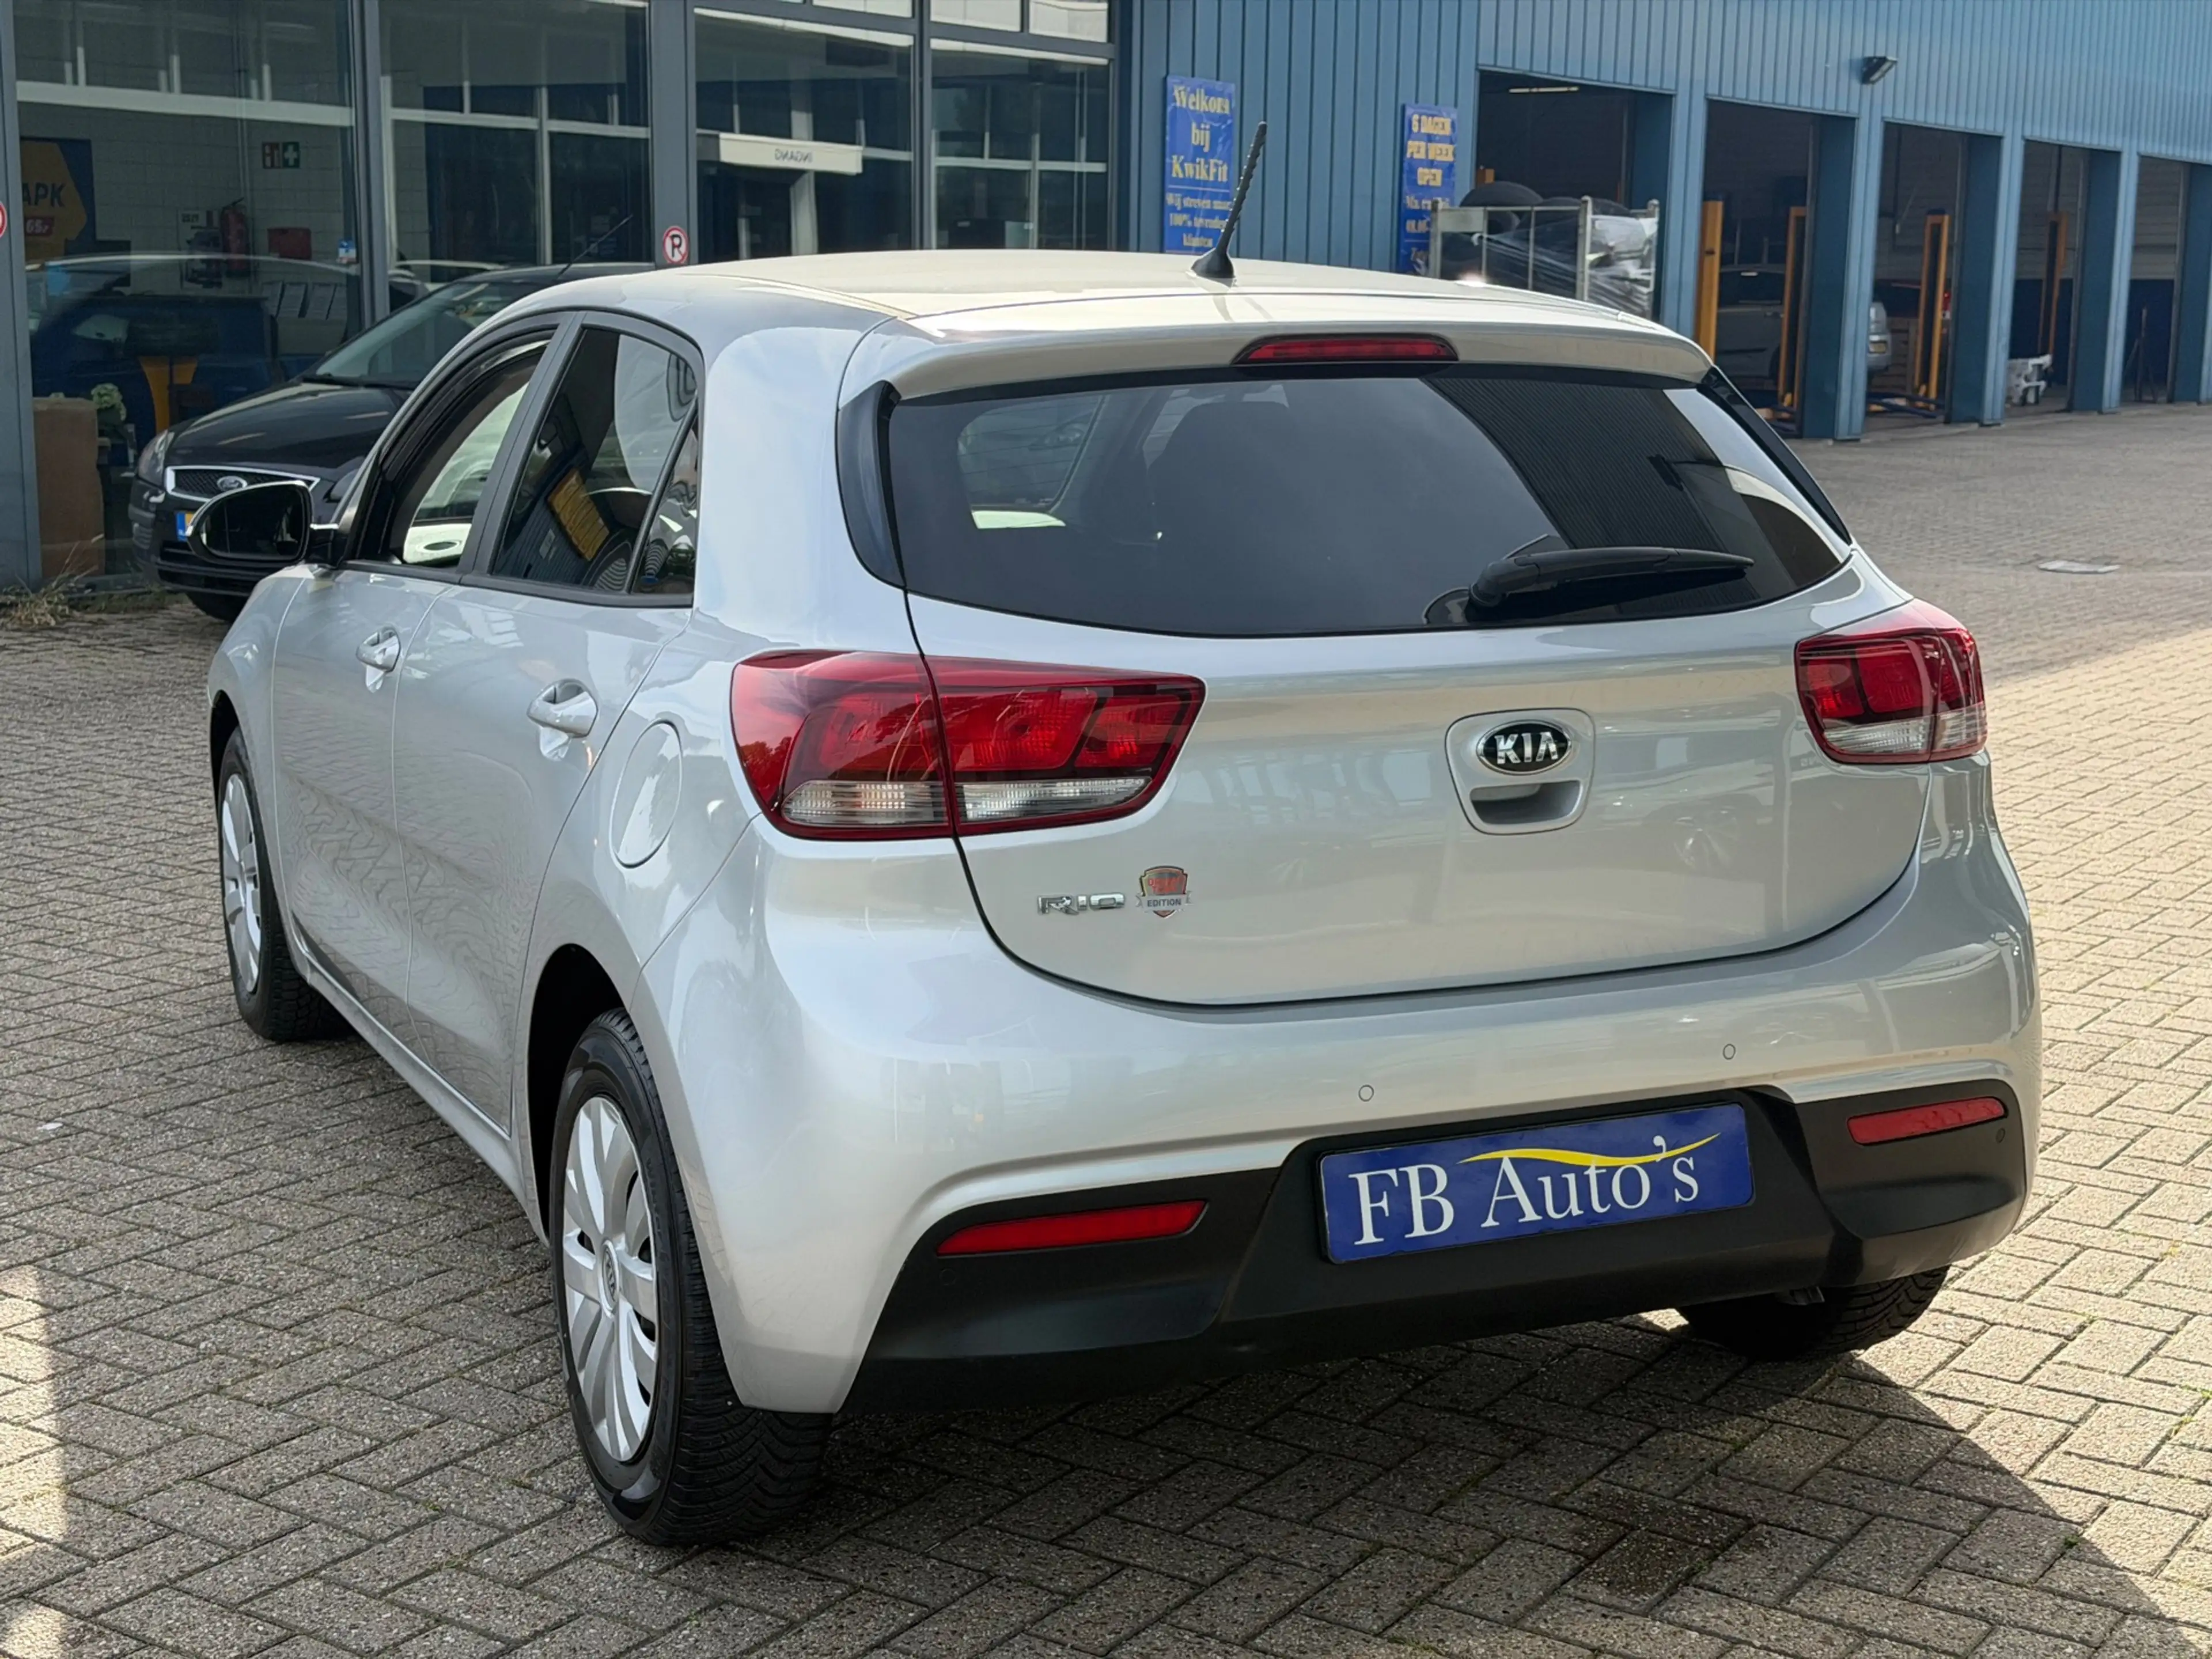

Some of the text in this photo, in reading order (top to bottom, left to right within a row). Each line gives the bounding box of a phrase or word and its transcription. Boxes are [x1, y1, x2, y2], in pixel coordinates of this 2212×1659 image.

[1172, 85, 1230, 113] Welkom
[1191, 122, 1210, 153] bij
[1421, 115, 1451, 136] DAGEN
[1407, 140, 1426, 159] PER
[1171, 154, 1228, 182] KwikFit
[1417, 167, 1442, 187] OPEN
[1494, 732, 1558, 764] KIA
[1037, 893, 1125, 916] RIO
[1147, 898, 1181, 907] EDITION
[1349, 1135, 1699, 1246] FB Auto's
